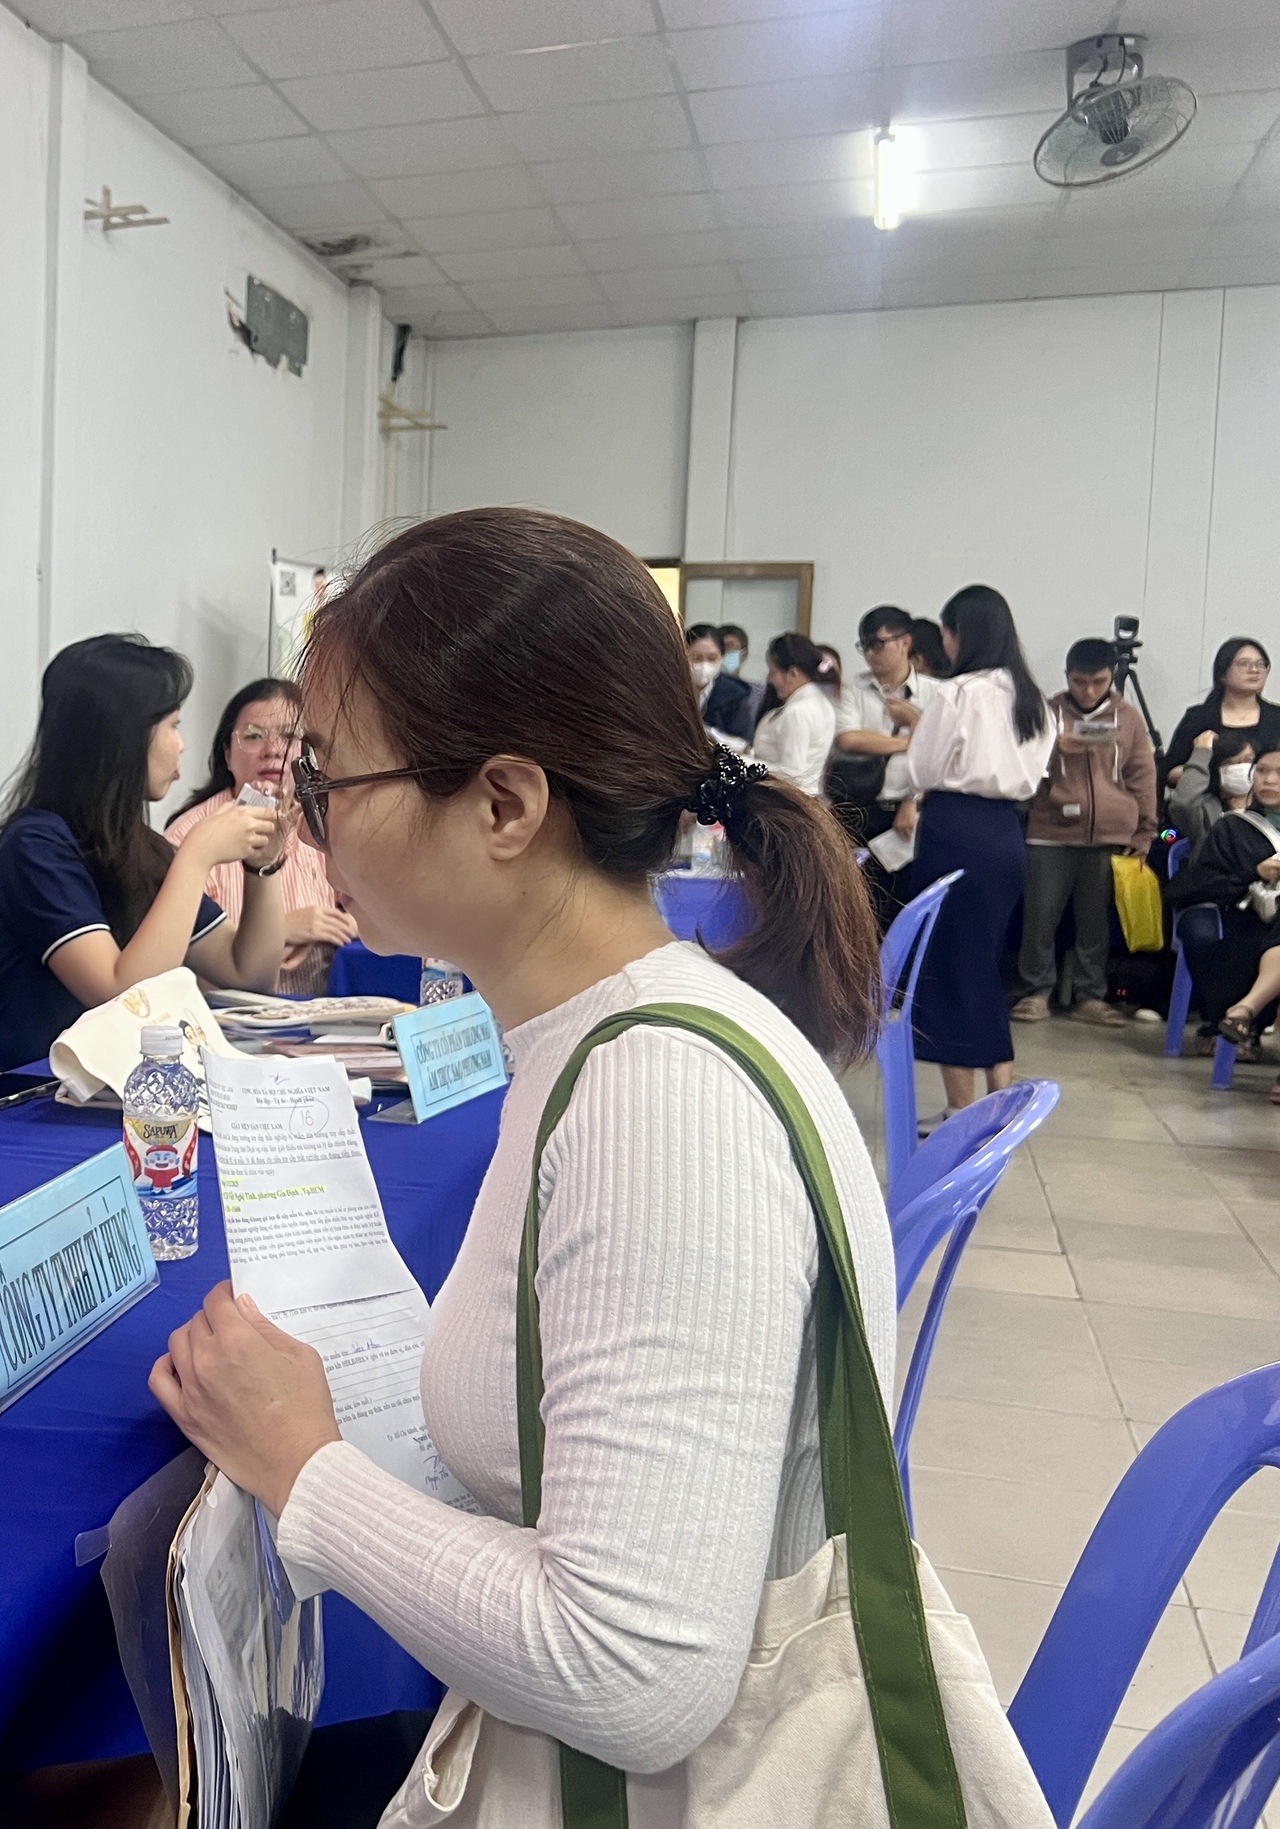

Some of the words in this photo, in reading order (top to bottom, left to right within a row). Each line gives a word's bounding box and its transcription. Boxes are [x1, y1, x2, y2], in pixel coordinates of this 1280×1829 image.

[300, 1109, 315, 1127] 16
[143, 1123, 178, 1139] SAPUWA
[31, 1259, 64, 1343] TY
